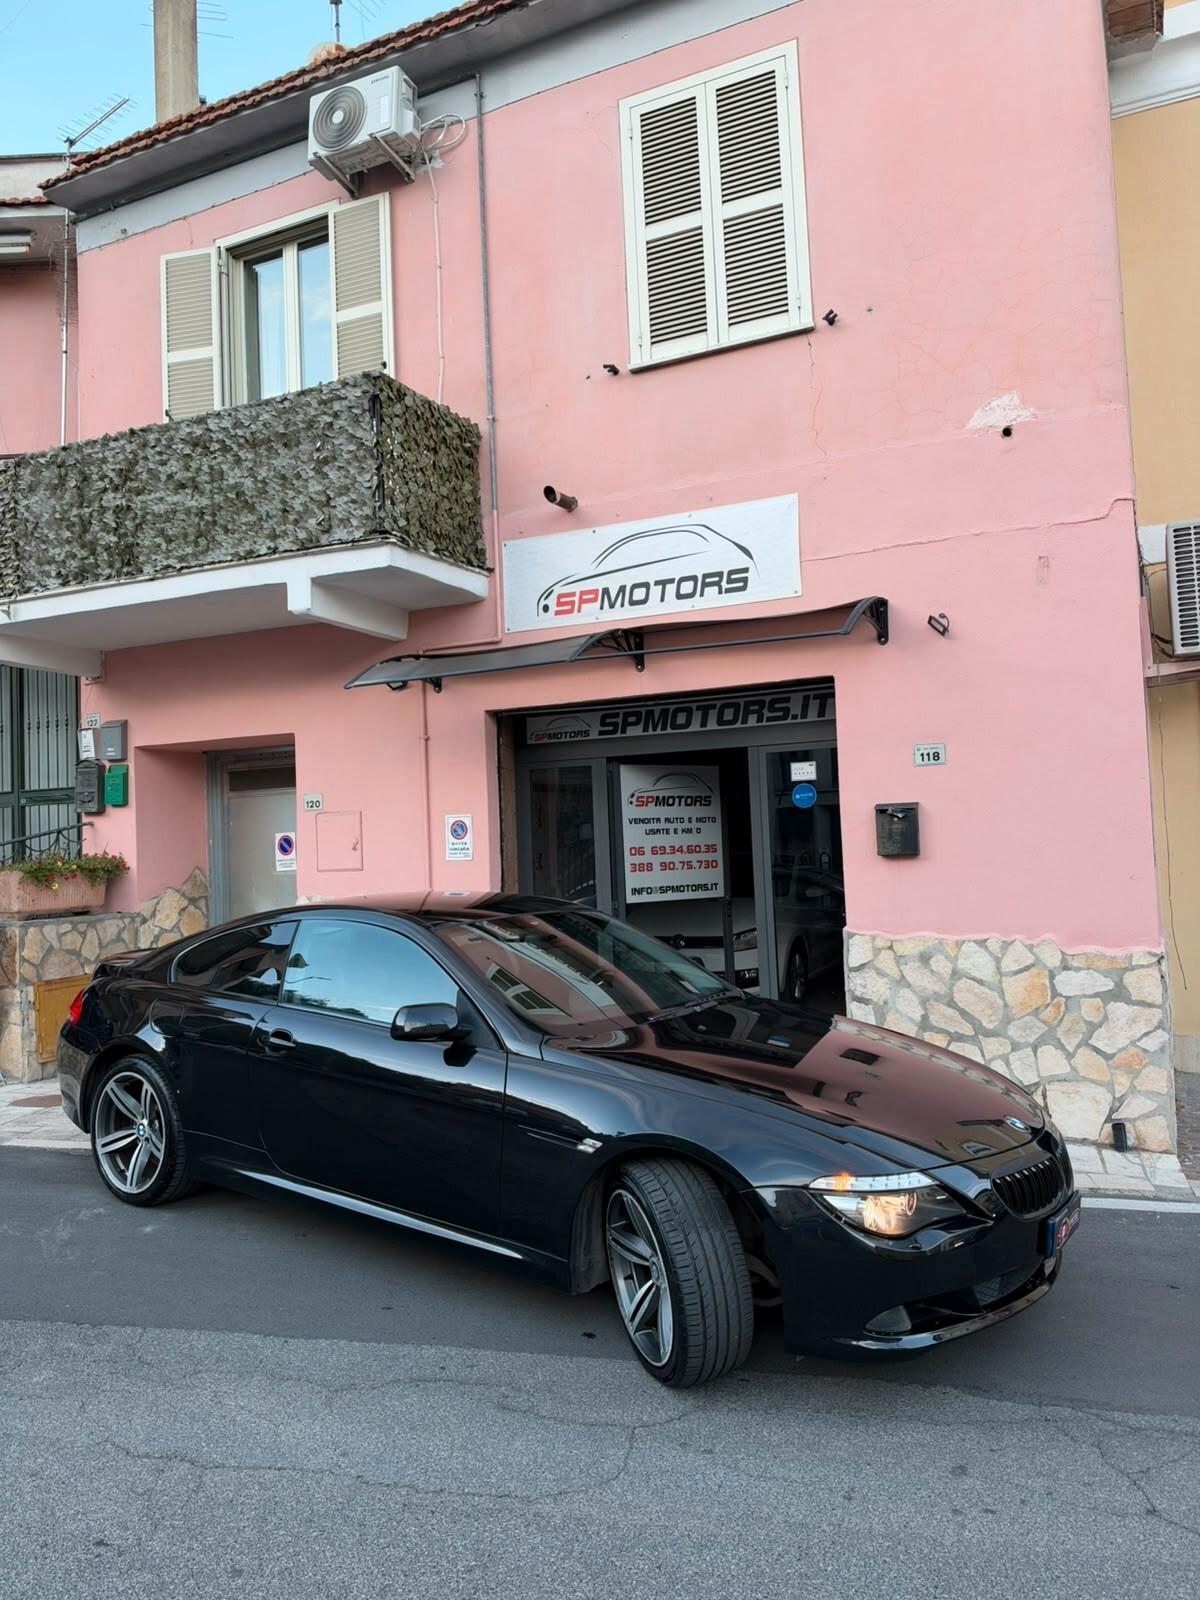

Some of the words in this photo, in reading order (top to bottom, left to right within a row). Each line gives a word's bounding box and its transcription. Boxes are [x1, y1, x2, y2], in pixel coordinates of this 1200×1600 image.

[553, 566, 750, 617] SPMOTORS
[598, 693, 834, 737] SPMOTORS.IT
[533, 729, 591, 742] SPMOTORS
[920, 751, 940, 762] 118
[305, 800, 321, 809] 120
[635, 795, 712, 808] SPMOTORS
[628, 817, 661, 825] VENDITA
[664, 817, 685, 825] AUTO
[695, 816, 717, 824] MOTO
[644, 828, 670, 836] USATE
[673, 827, 679, 835] E
[681, 827, 693, 835] KM
[629, 846, 646, 857] 06
[650, 843, 718, 856] 69.34.60.35
[630, 862, 654, 873] 388
[659, 860, 719, 872] 90.75.730
